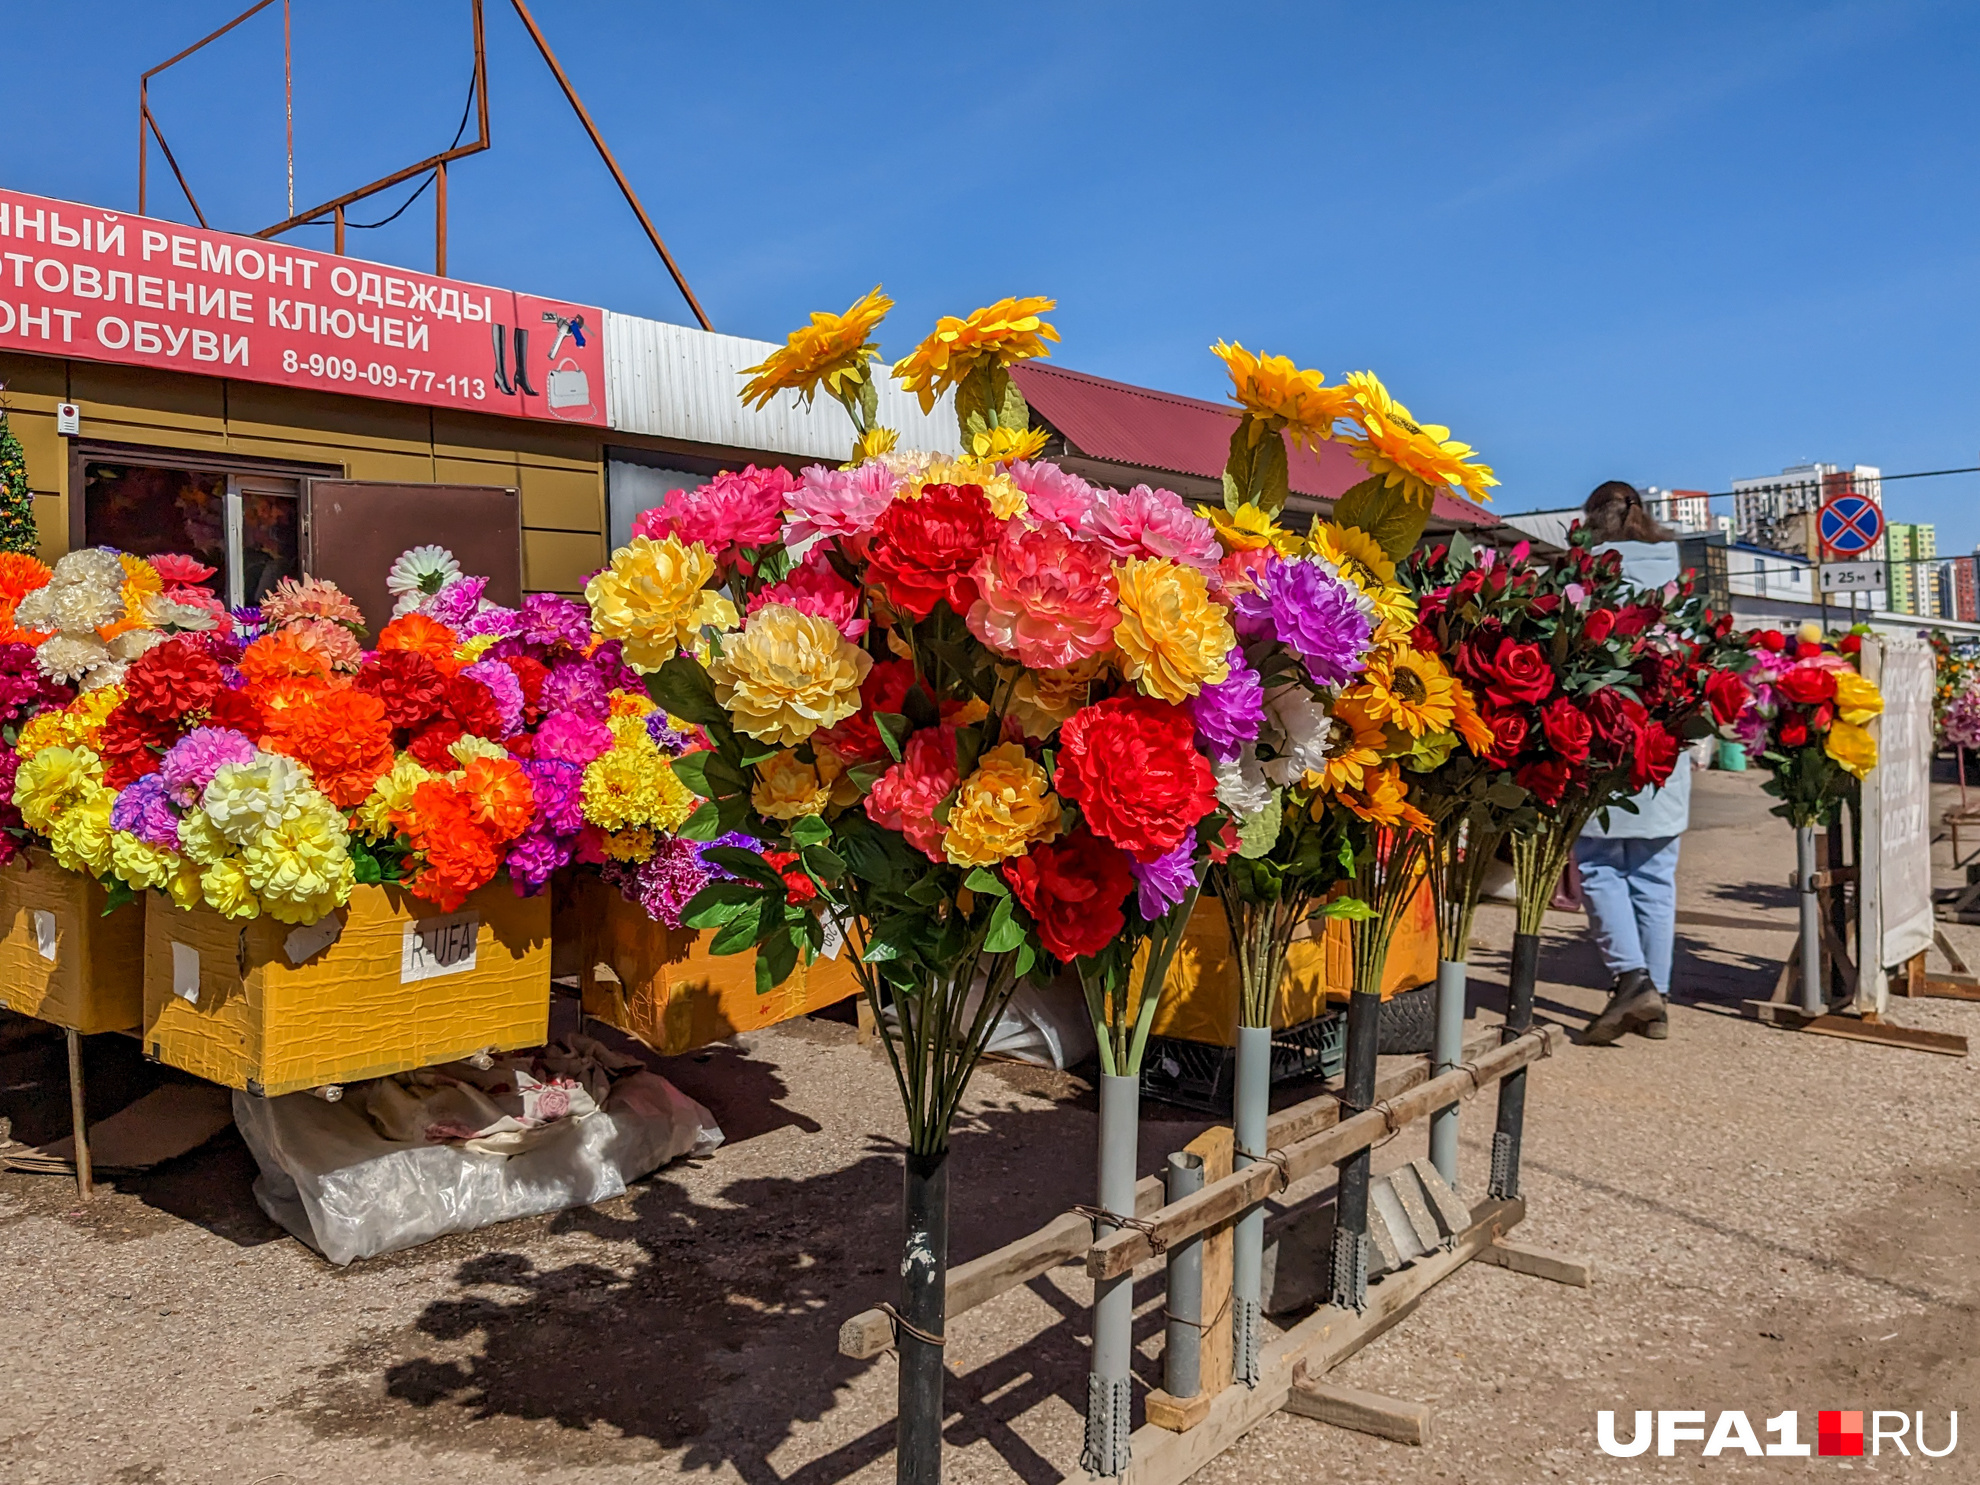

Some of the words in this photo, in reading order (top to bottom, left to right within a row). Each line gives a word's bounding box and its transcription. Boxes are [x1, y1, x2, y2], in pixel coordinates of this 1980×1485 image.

[0, 252, 254, 325] ТОВЛЕНИЕ
[268, 296, 430, 353] КЛЮЧЕЙ
[142, 230, 318, 286] РЕМОНТ
[330, 266, 492, 324] ОДЕЖДЫ
[96, 316, 249, 368] ОБУВИ
[282, 349, 486, 401] 8-909-09-77-113
[1838, 571, 1855, 584] 25
[411, 922, 471, 969] R-UFA
